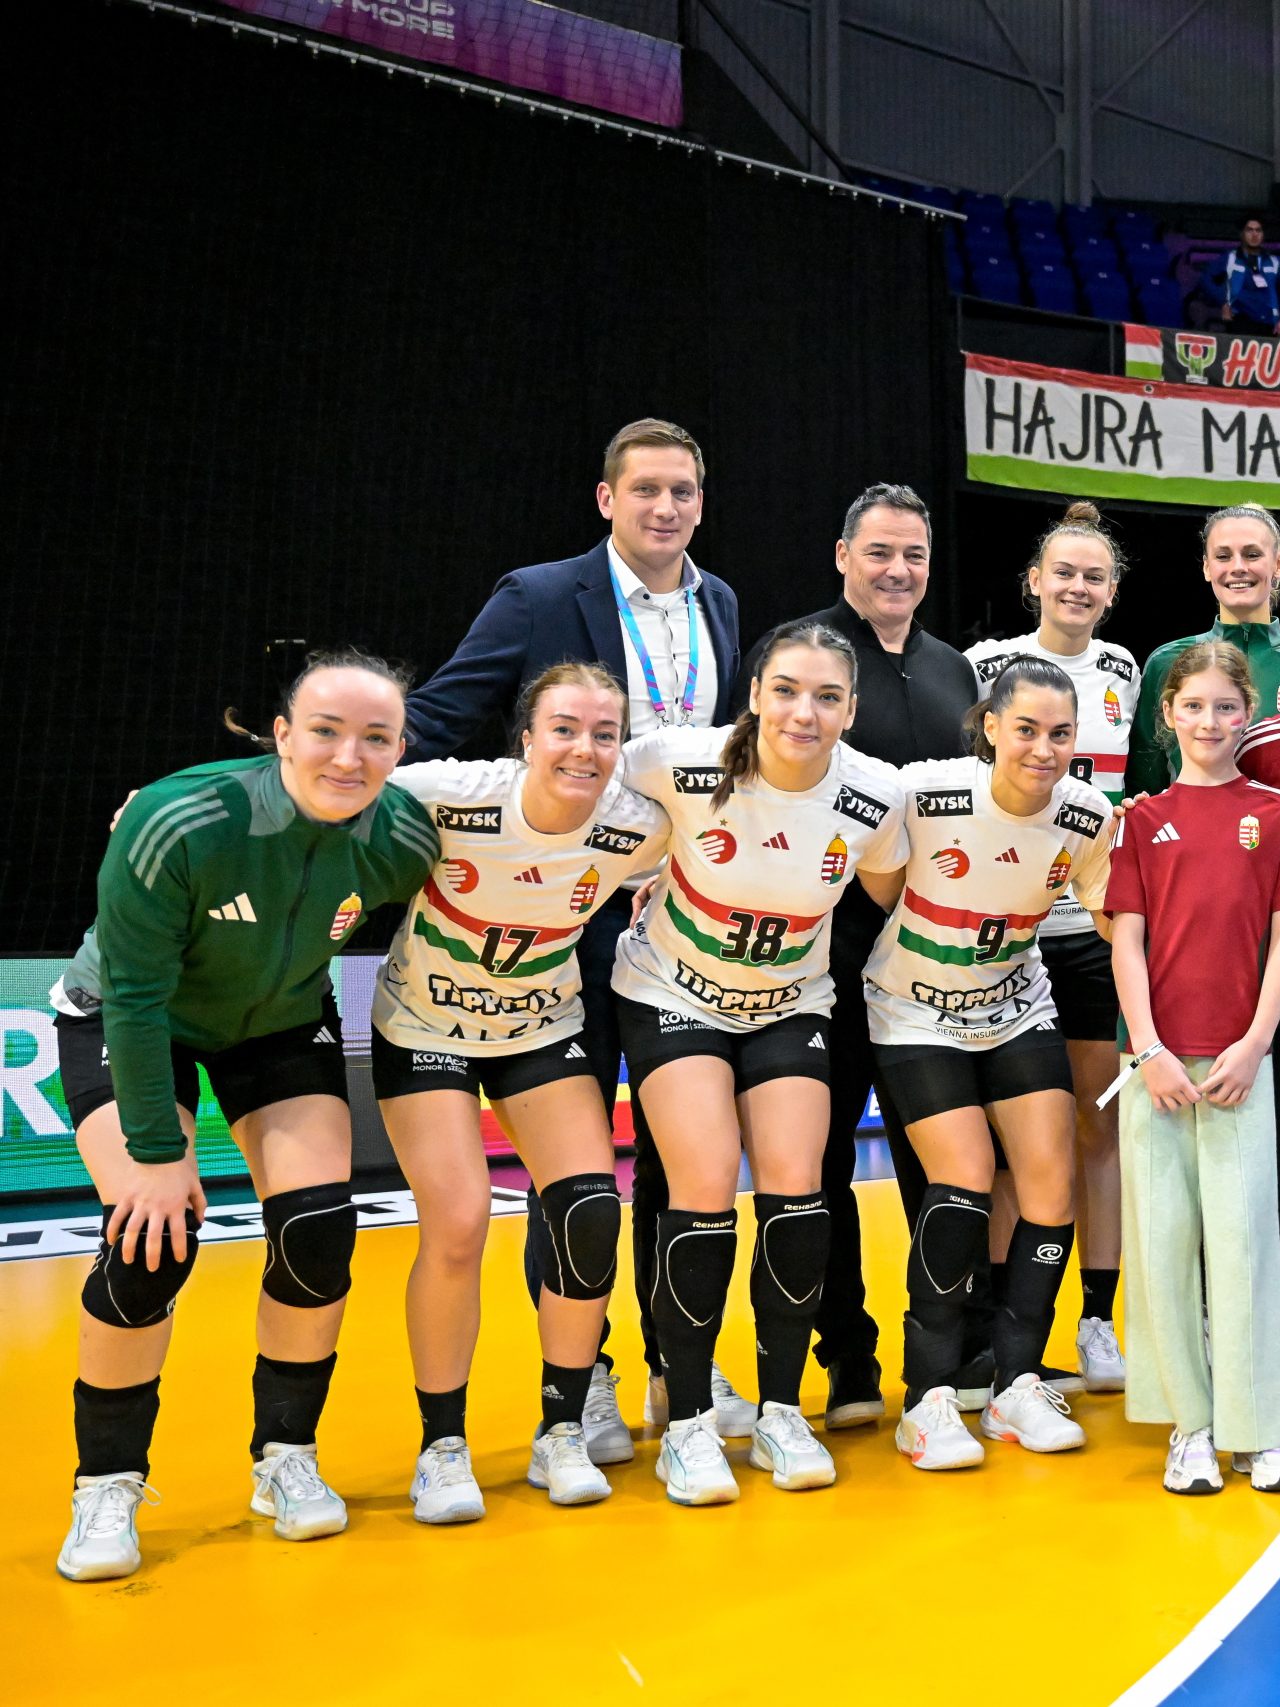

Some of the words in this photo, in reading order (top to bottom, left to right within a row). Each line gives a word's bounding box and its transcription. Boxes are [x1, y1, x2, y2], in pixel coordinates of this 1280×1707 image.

[1103, 659, 1132, 677] JYSK
[685, 773, 726, 788] JYS
[846, 796, 885, 823] JYSK
[928, 795, 971, 811] JYSK
[448, 812, 499, 827] JYSK
[1064, 810, 1101, 833] JYSK
[596, 833, 641, 850] JYSK
[720, 910, 790, 964] 38
[973, 917, 1009, 962] 9
[479, 924, 541, 975] 17
[660, 1024, 689, 1035] MONOR
[935, 1026, 968, 1039] VIENNA
[412, 1064, 443, 1072] MONOR
